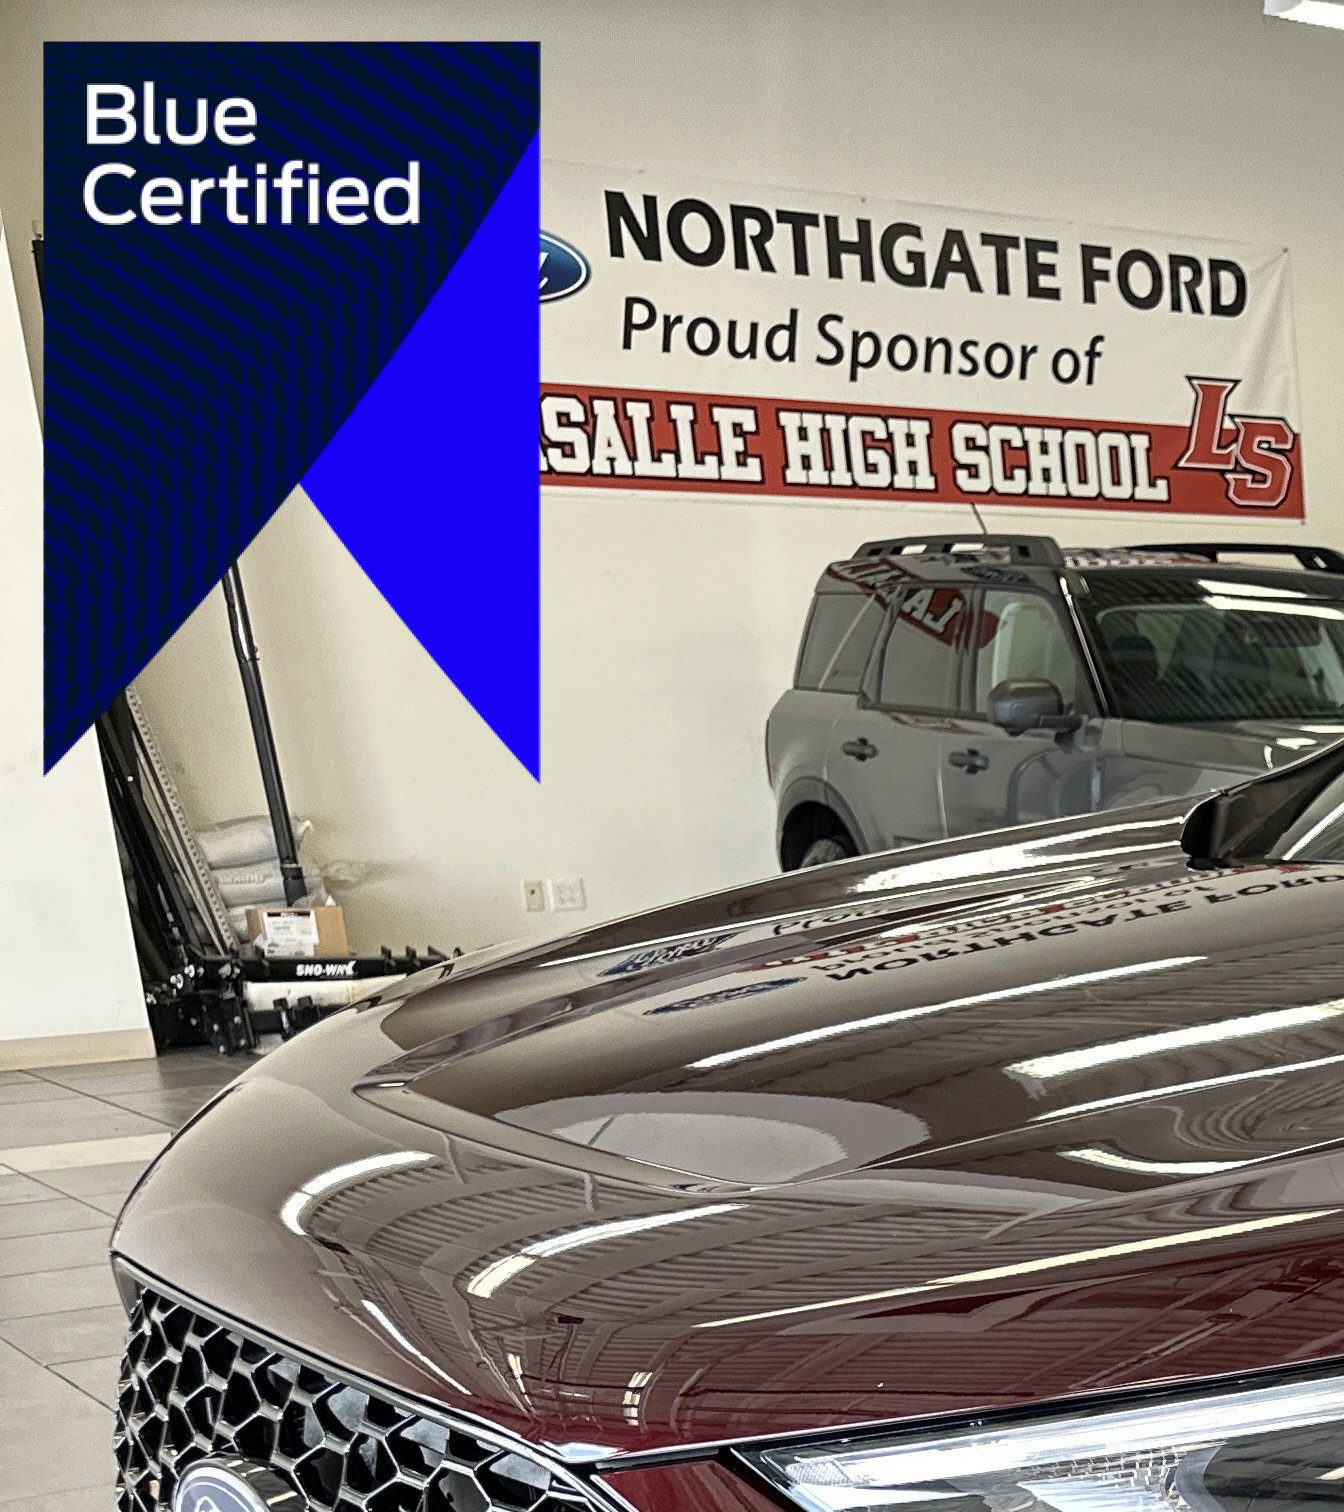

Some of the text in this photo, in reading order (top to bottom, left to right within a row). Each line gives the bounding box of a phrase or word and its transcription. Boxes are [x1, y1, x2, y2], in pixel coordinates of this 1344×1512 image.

[604, 190, 1062, 301] NORTHGATE
[1080, 243, 1248, 318] FORD
[622, 296, 1104, 386] Proud Sponsor of
[540, 394, 1171, 502] SALLE HIGH SCHOOL
[1172, 374, 1294, 508] LS
